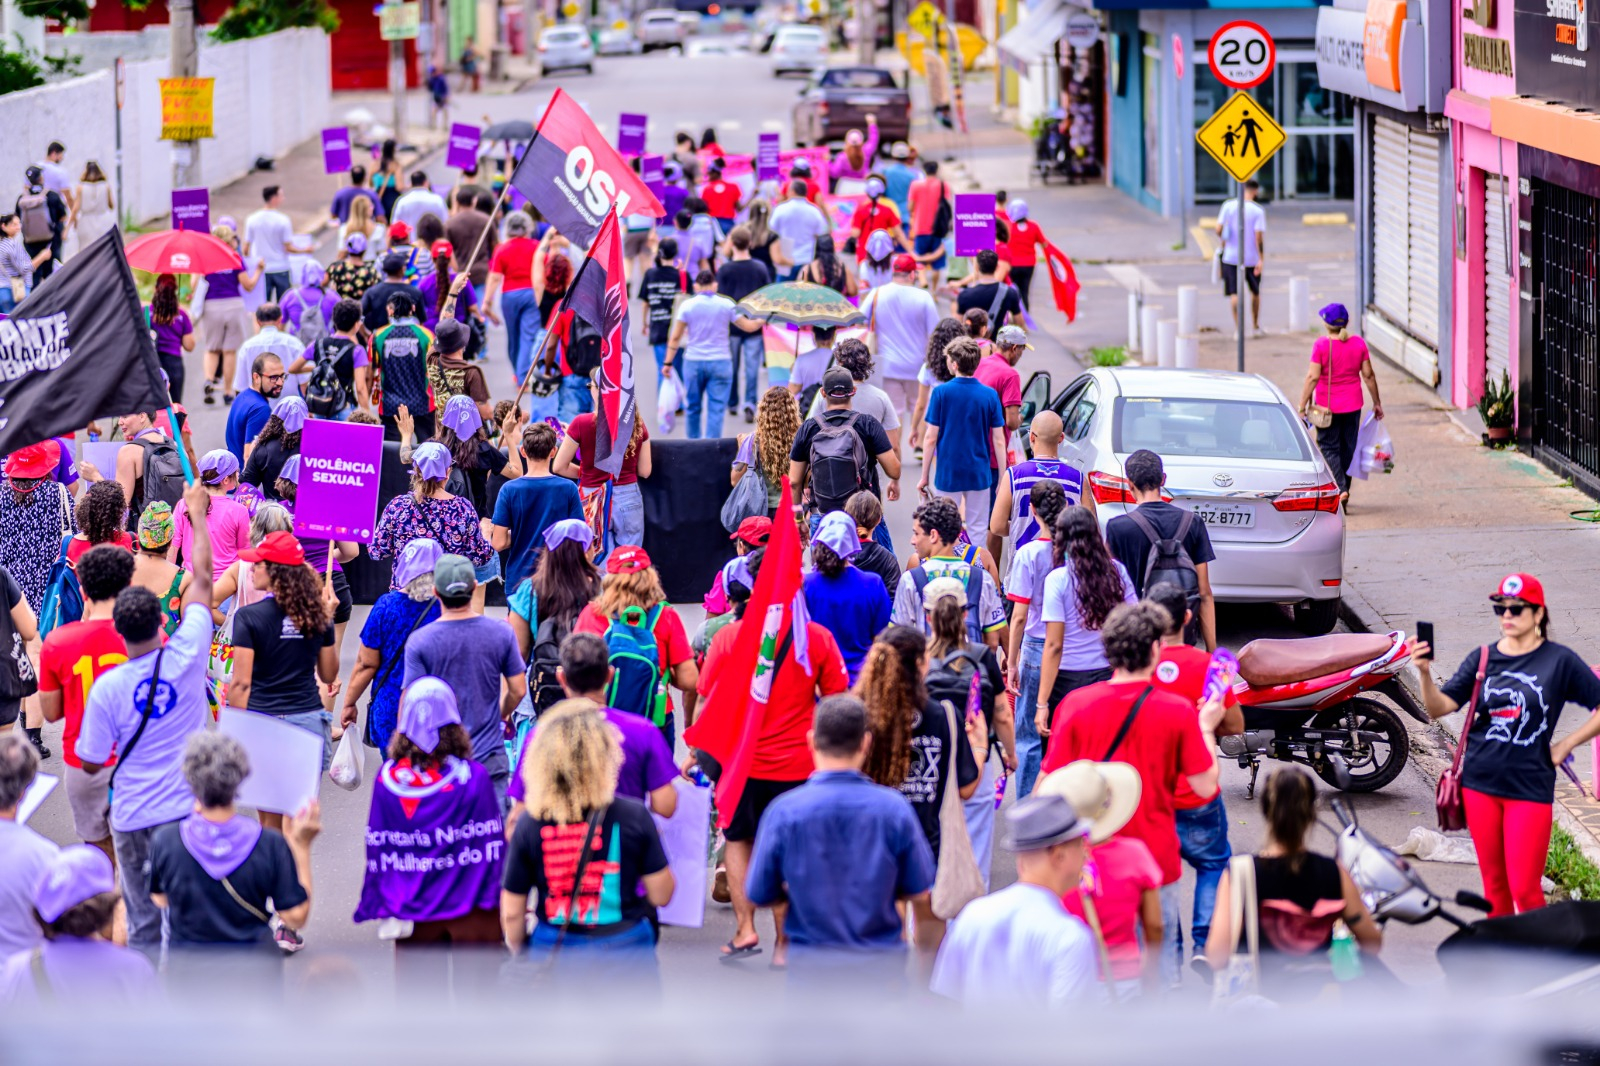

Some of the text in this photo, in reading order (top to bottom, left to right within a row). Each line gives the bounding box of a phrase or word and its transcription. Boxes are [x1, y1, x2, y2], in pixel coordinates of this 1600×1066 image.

[1220, 38, 1267, 66] 20
[956, 212, 994, 220] VIOLÊNCIA
[304, 456, 376, 475] VIOLÊNCIA
[312, 471, 365, 487] SEXUAL
[458, 845, 483, 866] do
